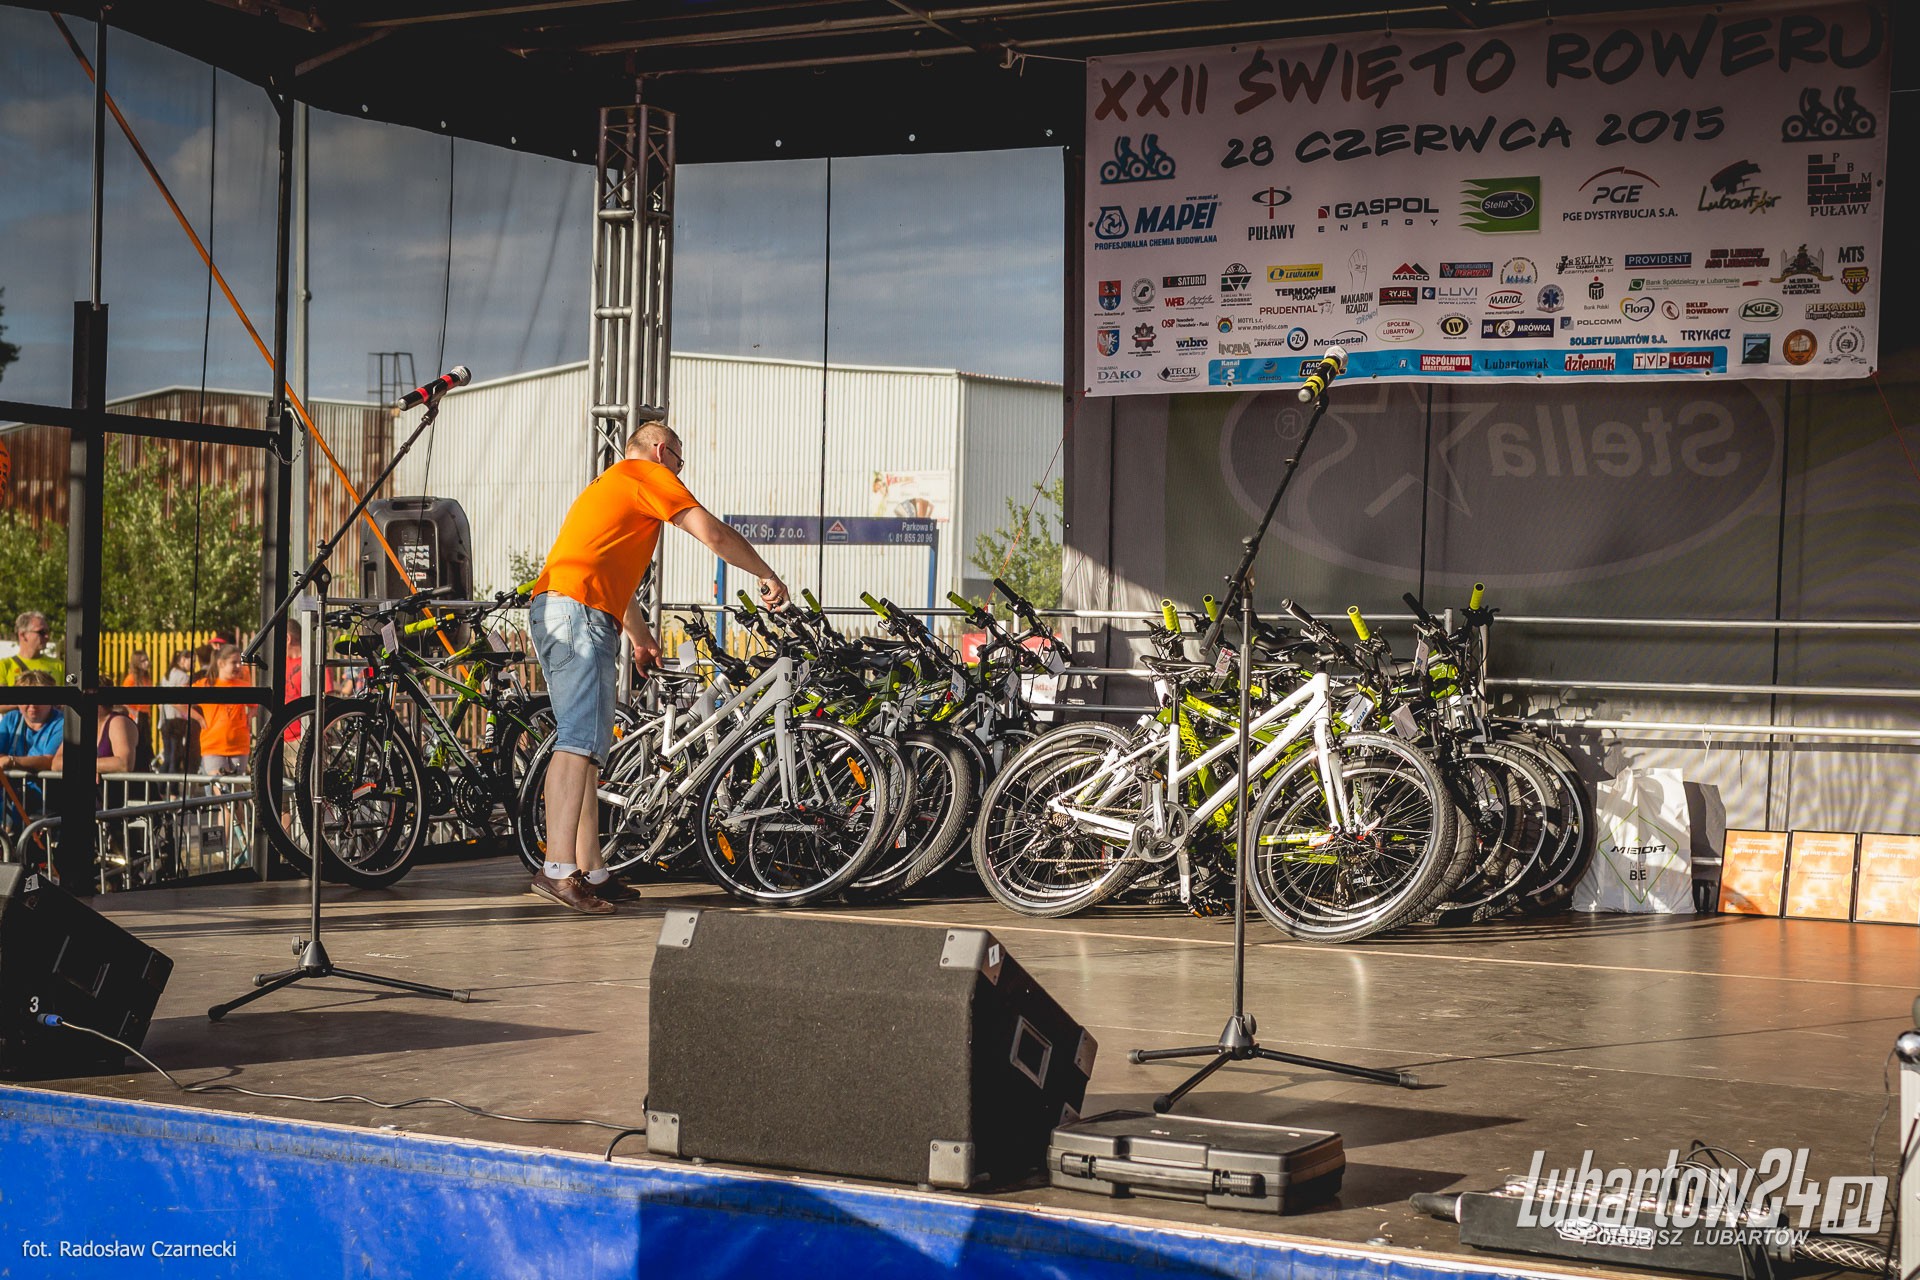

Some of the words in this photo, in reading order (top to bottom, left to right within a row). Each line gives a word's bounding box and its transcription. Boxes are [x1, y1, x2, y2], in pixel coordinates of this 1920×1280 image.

[1095, 63, 1208, 121] XXII
[1234, 39, 1516, 116] ŚWIĘTO
[1546, 4, 1883, 88] ROWERU
[1220, 135, 1274, 169] 28
[1295, 116, 1572, 162] CZERWCA
[1596, 106, 1723, 145] 2015
[1832, 153, 1840, 163] P
[1847, 162, 1854, 172] B
[1861, 172, 1871, 182] M
[1186, 193, 1218, 202] www.mapei.pl
[1592, 184, 1643, 205] PGE
[1335, 197, 1439, 219] GASPOL
[1485, 199, 1508, 210] Stella
[1563, 211, 1582, 221] PGE
[1584, 209, 1656, 221] DYSTRYBUCJA
[1658, 209, 1678, 218] S.A.
[1810, 203, 1869, 218] PUŁAWY
[1134, 201, 1218, 234] MAPEI
[1248, 224, 1295, 241] PUŁAWY
[1095, 239, 1148, 250] PROFESJONALNA
[1150, 237, 1175, 247] CHEMIA
[1177, 235, 1218, 246] BUDOWLANA
[1629, 254, 1689, 265] PROVIDENT
[1838, 246, 1864, 263] MTS
[1569, 256, 1613, 266] REKLAMY
[1286, 270, 1320, 279] LEWIATAN
[1177, 275, 1205, 287] SATURN
[1663, 279, 1698, 287] Spółdzielczy
[1275, 286, 1336, 297] TERMOCHEM
[1439, 287, 1477, 296] LUVI
[1341, 292, 1373, 304] MAKARON
[1489, 296, 1522, 304] MARIOL
[1260, 305, 1317, 315] PRUDENTIAL
[1346, 303, 1368, 314] RZĄDZI
[1625, 303, 1649, 314] Flora
[1805, 302, 1866, 312] PIEKARNIA
[1162, 318, 1175, 328] OSP
[1518, 323, 1550, 332] MRÓWKA
[1577, 318, 1622, 326] POLCOMM
[1292, 334, 1304, 345] PZU
[1314, 335, 1363, 346] Mostostal
[1570, 337, 1602, 346] SOLBET
[1604, 333, 1650, 345] LUBARTÓW
[1652, 335, 1667, 344] S.A.
[1681, 329, 1731, 341] TRYKACZ
[1176, 337, 1208, 347] wibro
[1423, 355, 1470, 366] WSPÓLNOTA
[1485, 358, 1549, 371] Lubartowiak
[1565, 353, 1615, 371] dziennik
[1635, 356, 1667, 367] TVP
[1673, 355, 1711, 366] LUBLIN
[1098, 370, 1141, 380] DAKO
[1170, 367, 1196, 375] TECH
[1227, 368, 1235, 380] S
[760, 523, 776, 541] Sp.
[780, 527, 785, 537] z
[788, 527, 805, 538] o.o.
[902, 522, 928, 531] Parkowa
[930, 522, 934, 531] 6
[895, 533, 903, 543] 81
[904, 533, 915, 543] 855
[917, 533, 924, 543] 20
[422, 708, 466, 767] GIANT
[29, 996, 39, 1013] 3
